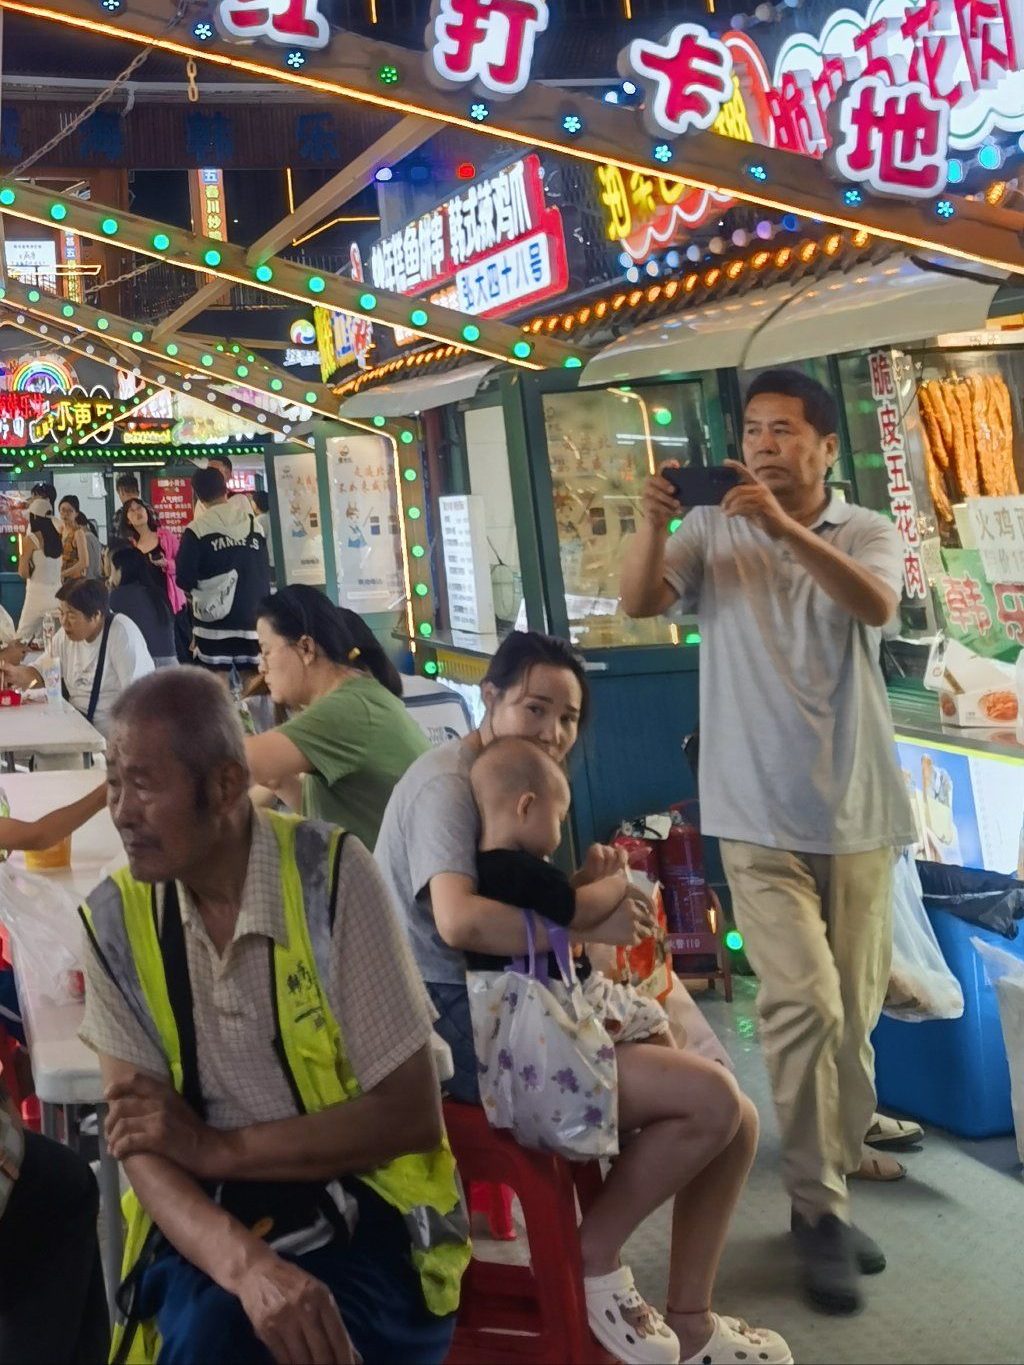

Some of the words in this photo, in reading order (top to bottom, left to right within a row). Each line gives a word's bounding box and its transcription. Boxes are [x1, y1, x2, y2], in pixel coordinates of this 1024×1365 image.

[869, 352, 927, 601] 脆皮五花肉
